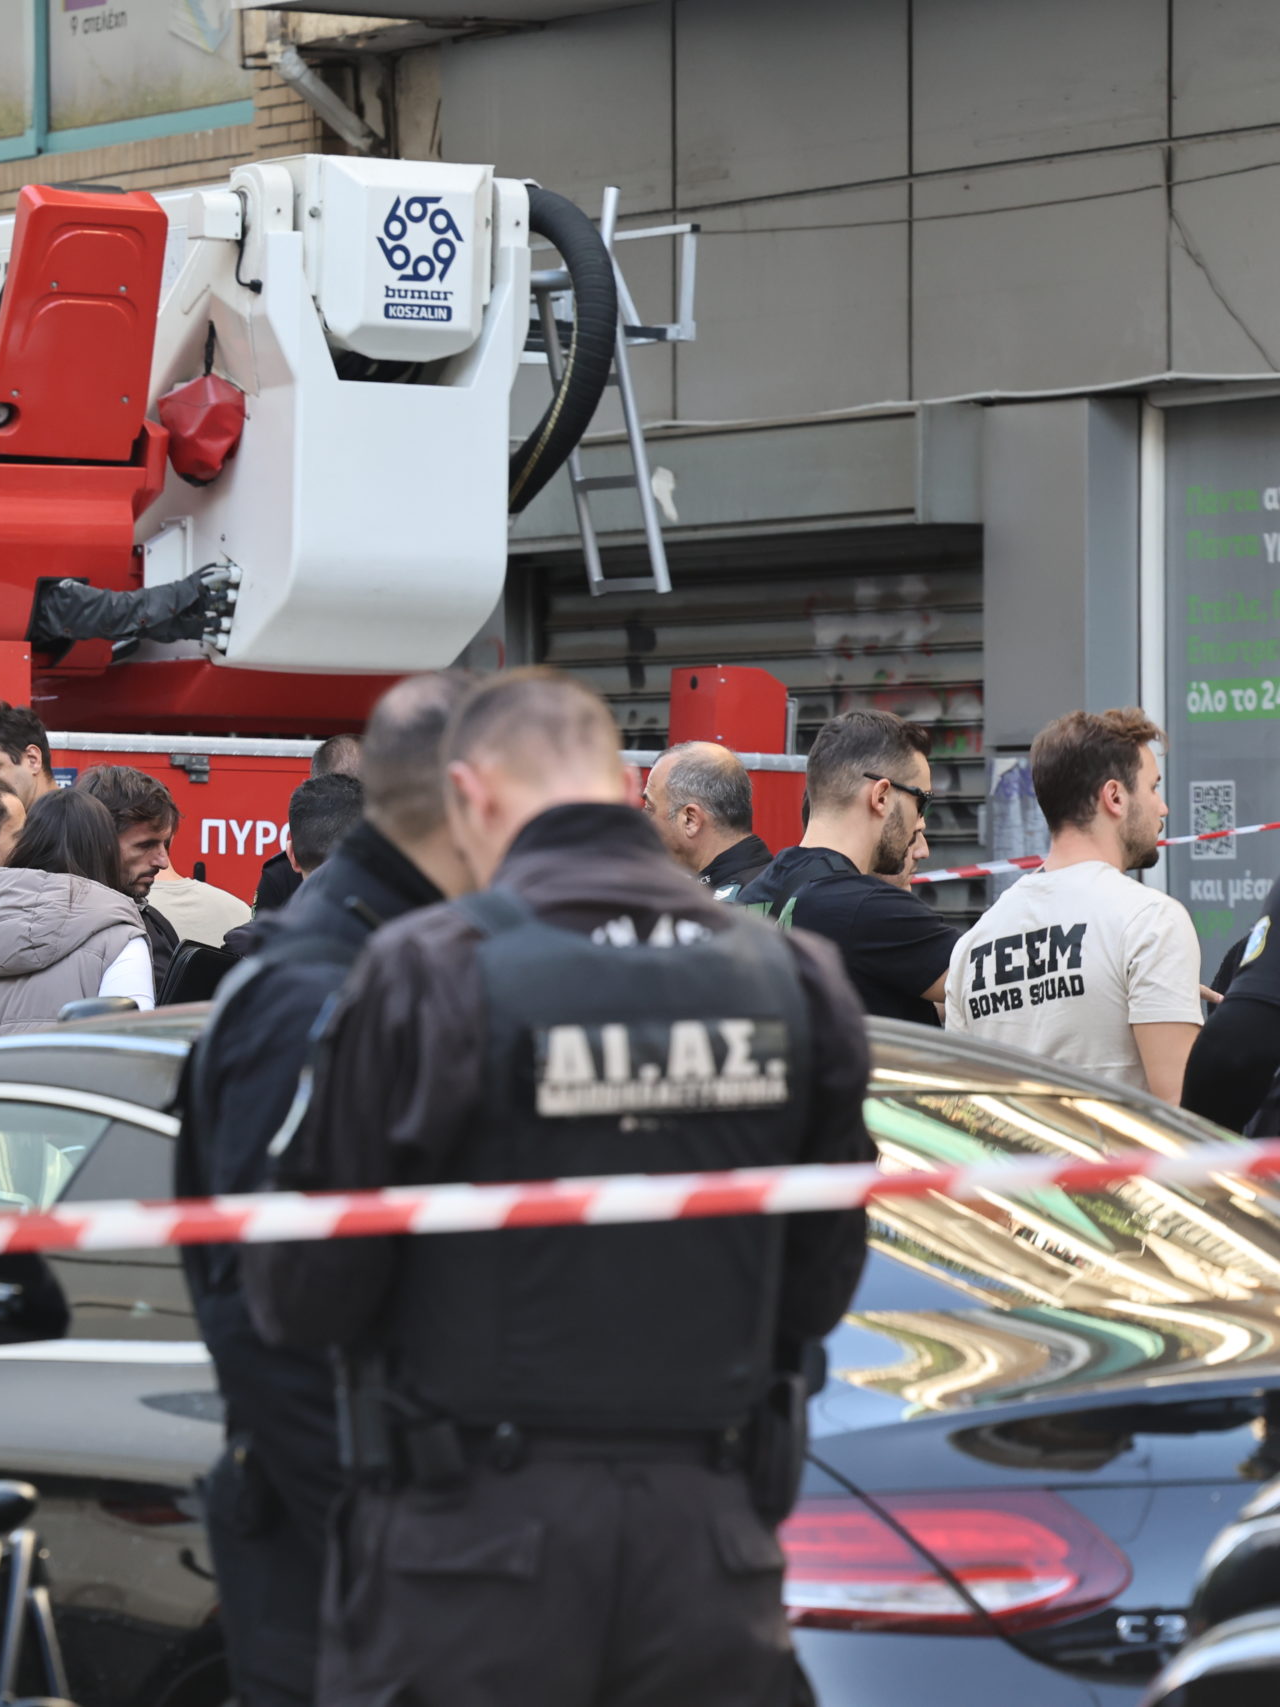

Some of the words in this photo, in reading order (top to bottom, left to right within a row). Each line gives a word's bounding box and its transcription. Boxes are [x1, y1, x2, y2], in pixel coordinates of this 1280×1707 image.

[384, 285, 454, 301] bumar
[388, 304, 449, 320] KOSZALIN
[1186, 681, 1228, 714] όλο
[1230, 688, 1258, 712] το
[970, 923, 1087, 992] TEEM
[969, 987, 1023, 1020] BOMB
